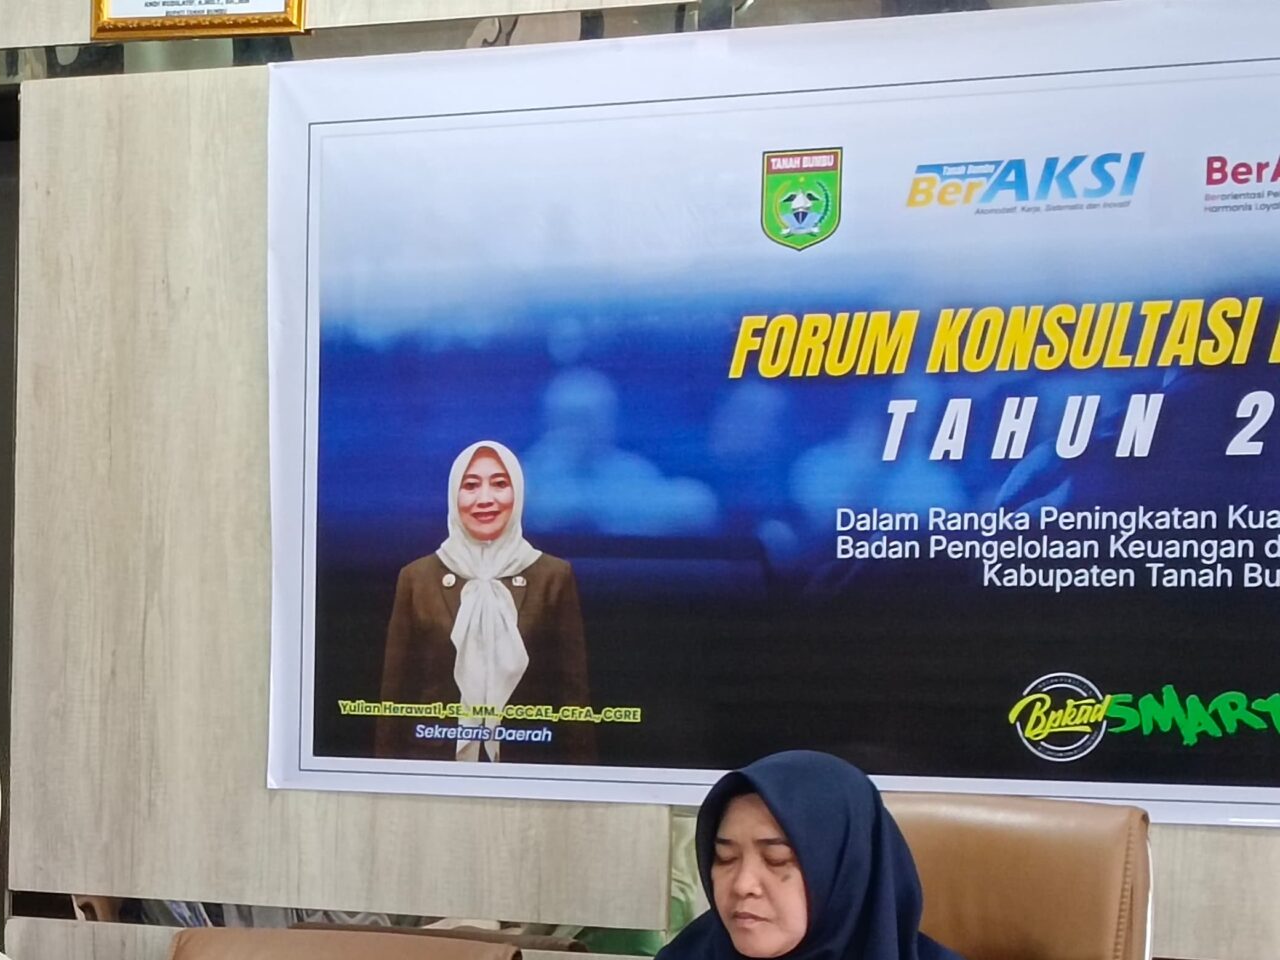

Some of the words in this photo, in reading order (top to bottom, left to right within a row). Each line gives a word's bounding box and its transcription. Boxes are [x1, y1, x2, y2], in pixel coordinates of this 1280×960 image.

[771, 156, 800, 170] TANAH
[728, 310, 920, 379] FORUM
[926, 297, 1263, 375] KONSULTASI
[882, 393, 1164, 461] TAHUN
[836, 508, 919, 531] Dalam
[928, 507, 1030, 537] Rangka
[1040, 505, 1217, 536] Peningkatan
[1228, 505, 1280, 529] Kua
[836, 536, 920, 559] Badan
[930, 535, 1099, 565] Pengelolaan
[1110, 534, 1255, 565] Keuangan
[982, 562, 1136, 592] Kabupaten
[1146, 563, 1233, 588] Tanah
[1243, 562, 1280, 588] Bu
[339, 700, 380, 714] Yulian
[382, 702, 446, 717] Herawati,
[602, 707, 641, 722] CGRE
[415, 724, 491, 740] Sekretaris
[494, 726, 552, 742] Daerah
